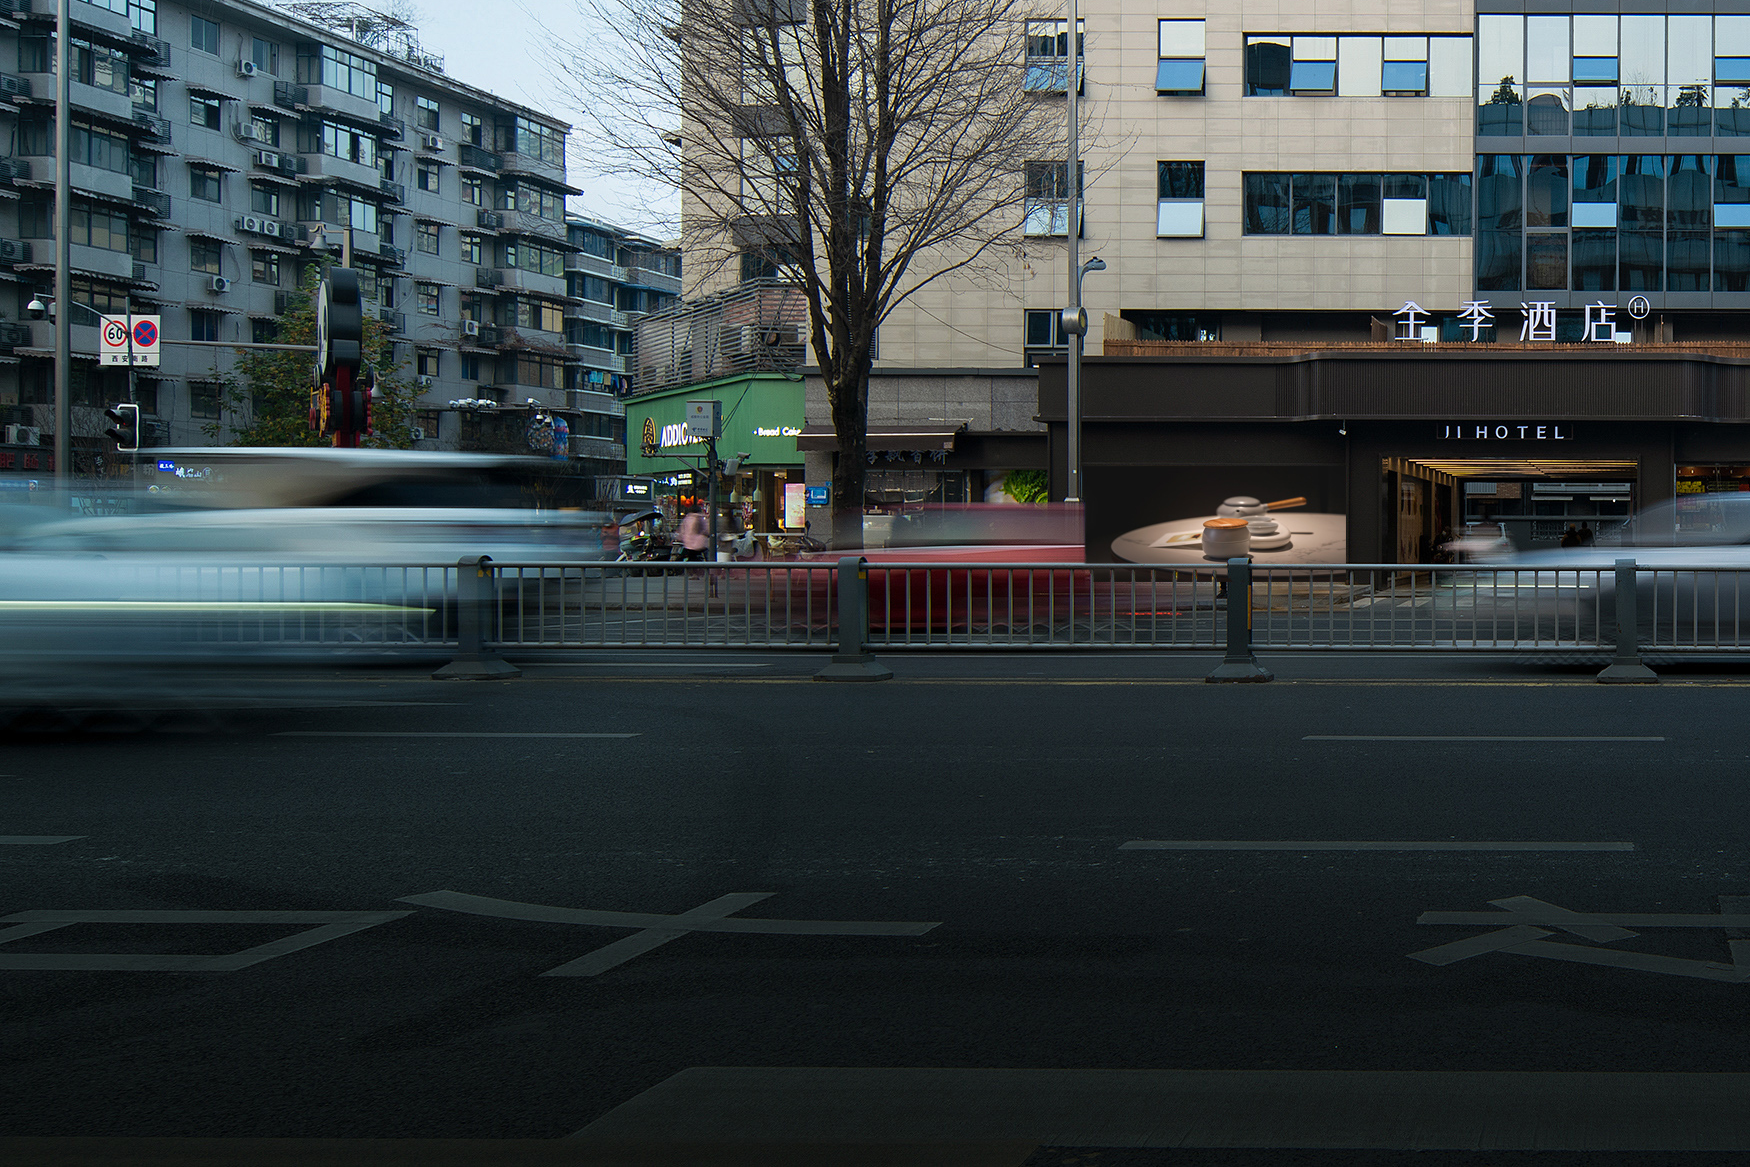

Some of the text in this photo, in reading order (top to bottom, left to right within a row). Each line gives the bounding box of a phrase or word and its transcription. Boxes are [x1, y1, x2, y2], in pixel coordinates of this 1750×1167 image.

[1392, 300, 1618, 343] 全季酒店
[108, 327, 123, 340] 60
[757, 426, 780, 438] Bread
[1445, 425, 1565, 439] JI HOTEL
